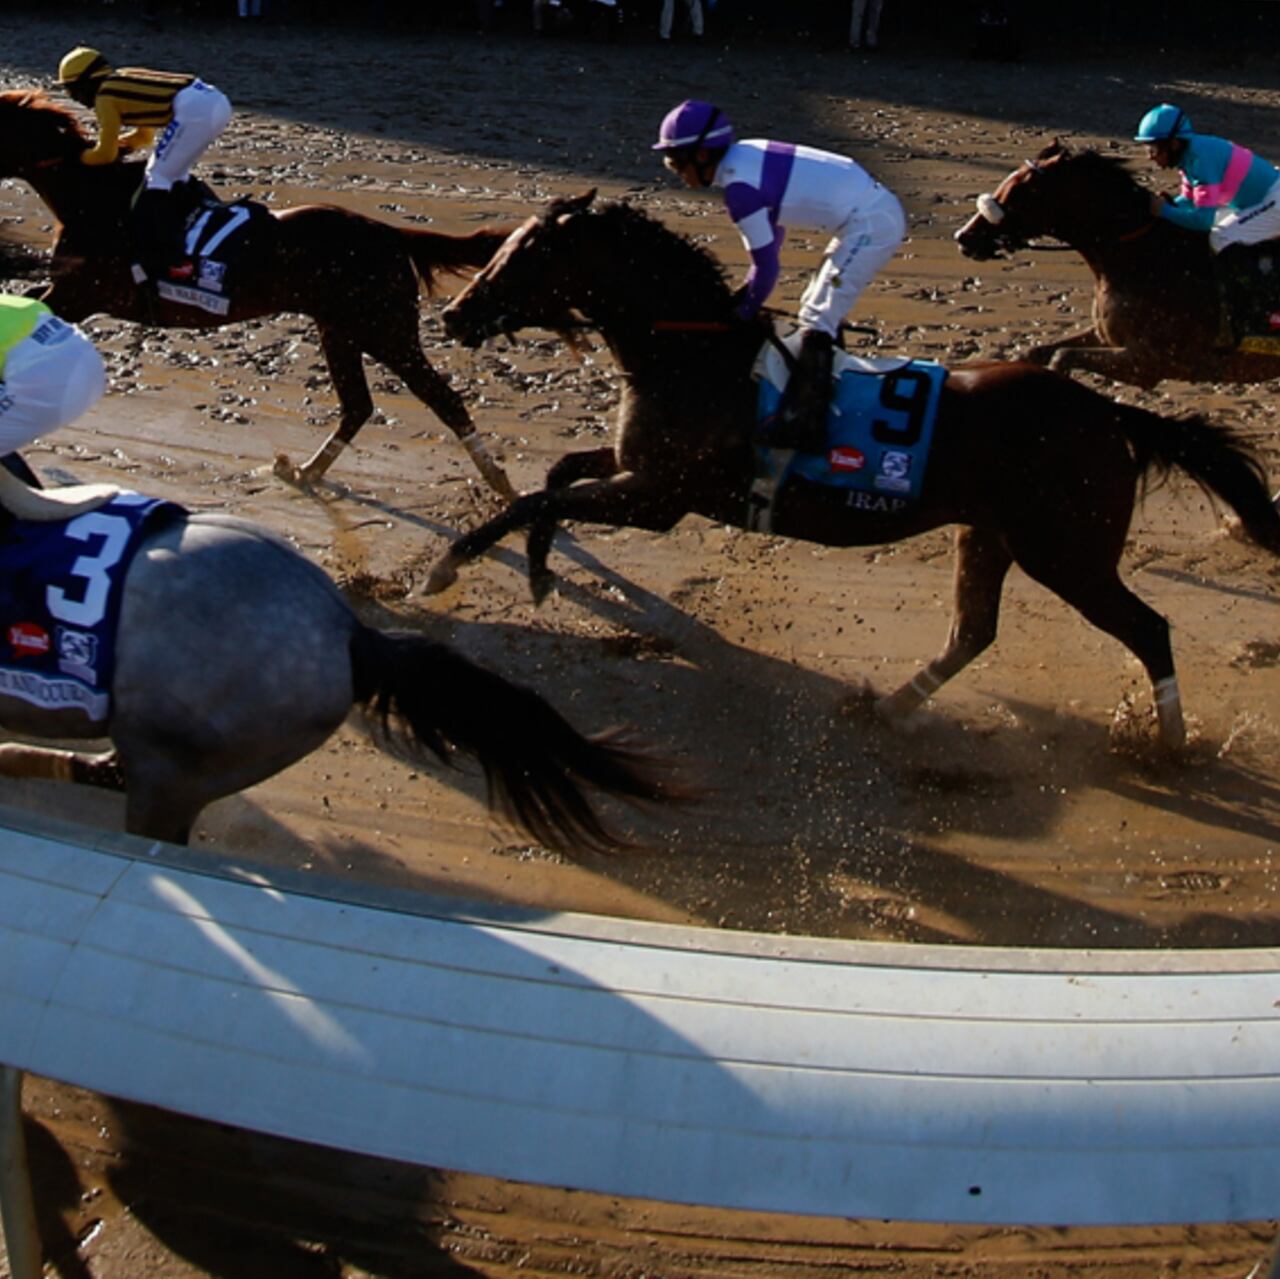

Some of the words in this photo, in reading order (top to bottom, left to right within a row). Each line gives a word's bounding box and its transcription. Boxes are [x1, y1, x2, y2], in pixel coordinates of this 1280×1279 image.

[872, 370, 931, 446] 9
[845, 489, 908, 513] IRAP
[45, 511, 134, 628] 3
